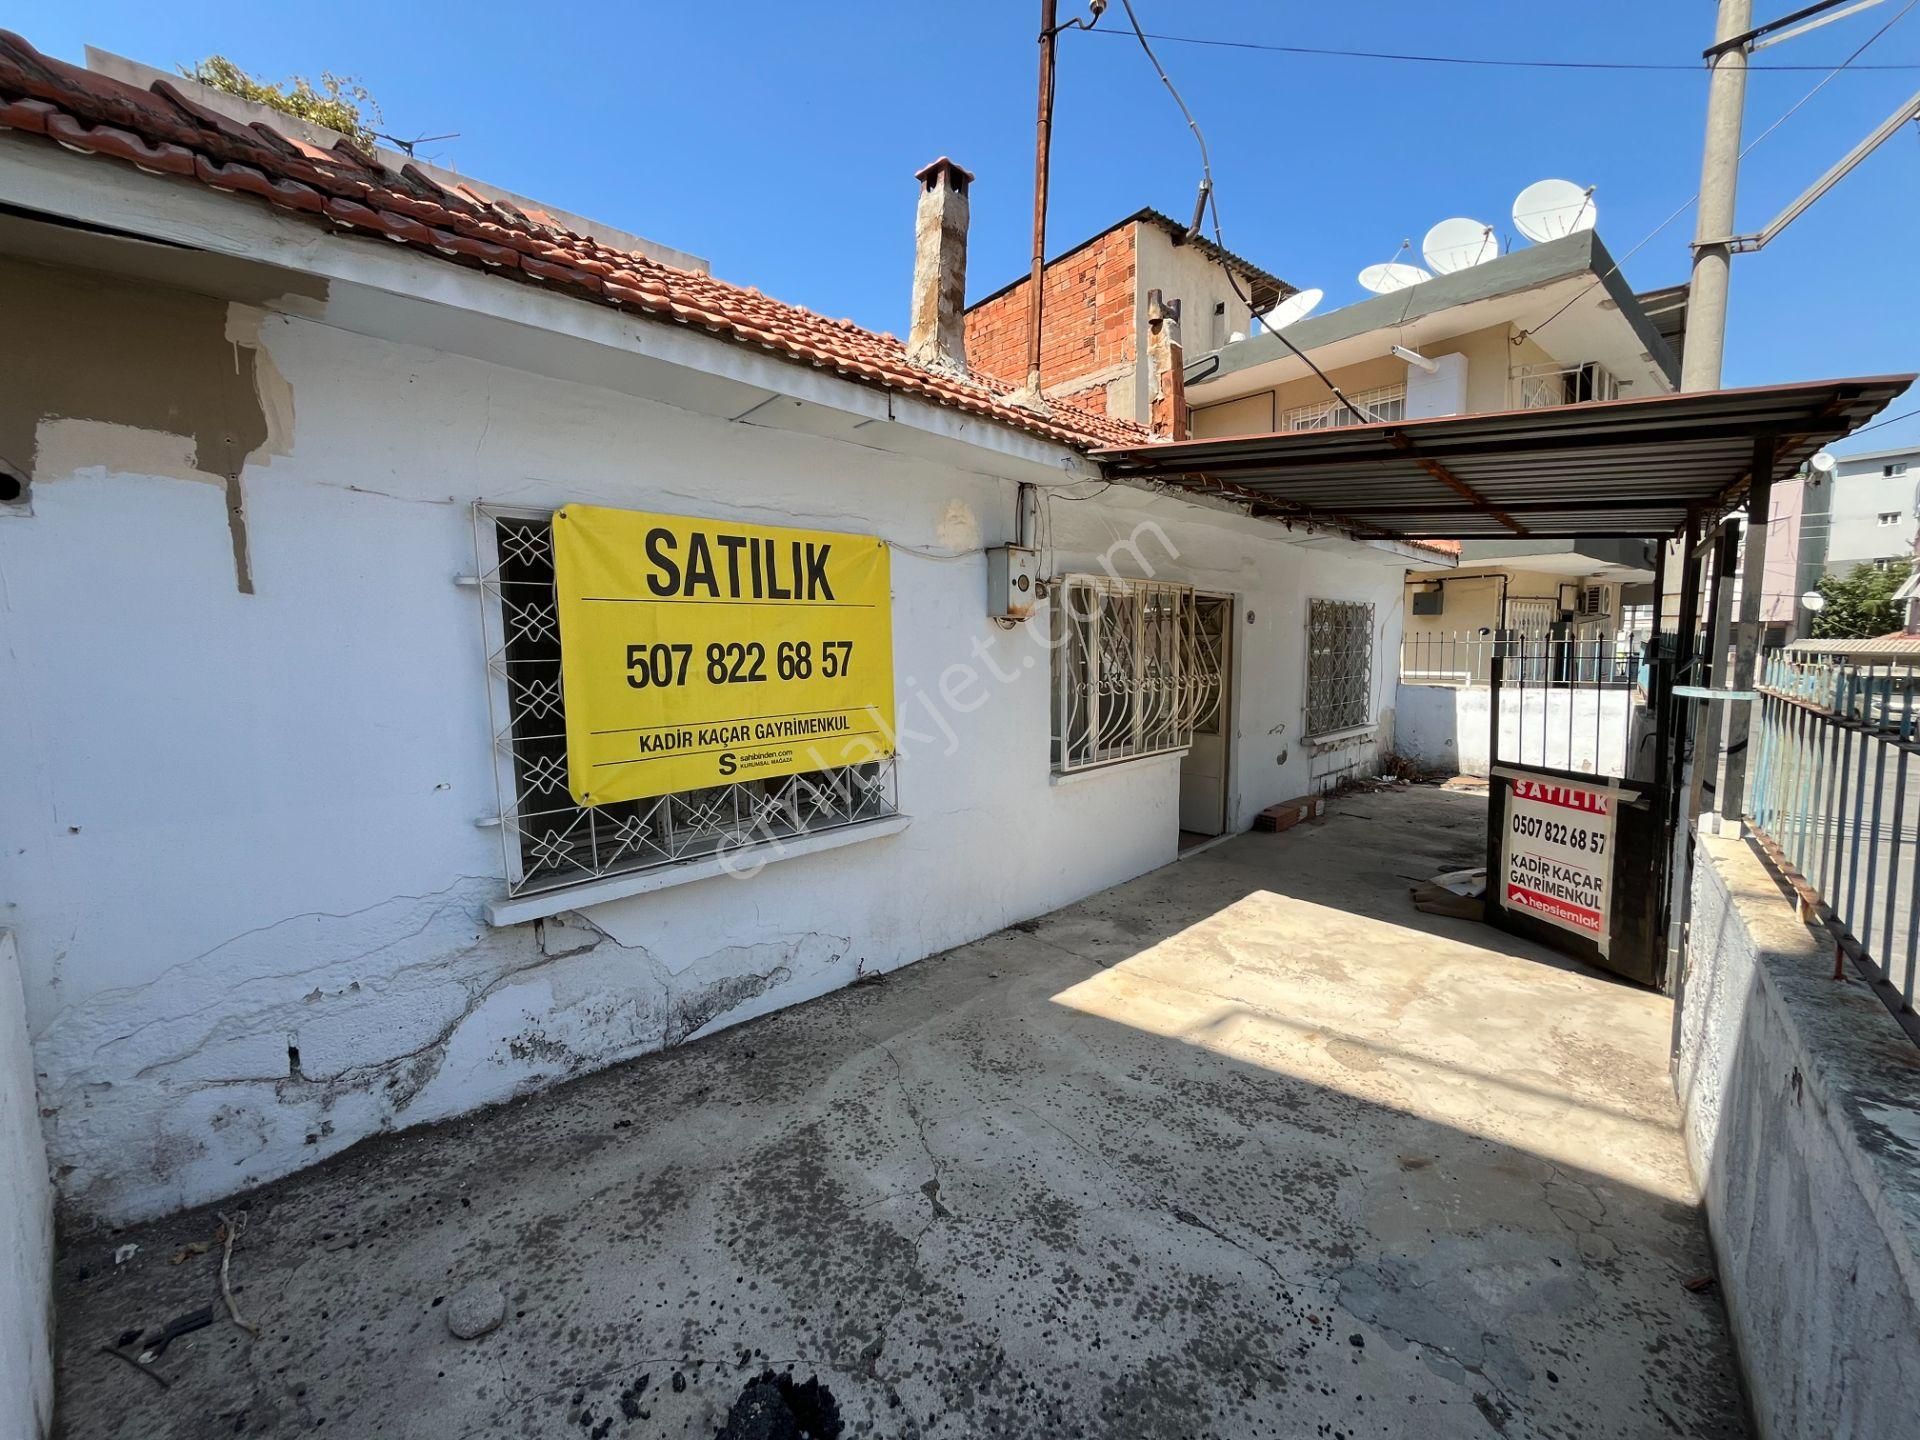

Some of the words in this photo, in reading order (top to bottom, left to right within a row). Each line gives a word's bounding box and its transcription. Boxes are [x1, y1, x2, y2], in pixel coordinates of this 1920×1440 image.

[645, 528, 835, 601] SATILIK
[626, 643, 692, 689] 507
[706, 641, 767, 685] 822
[777, 641, 812, 680] 68
[822, 641, 853, 678] 57
[639, 730, 692, 752] KADİR
[698, 727, 750, 748] KAÇAR
[755, 715, 850, 740] GAYRİMENKUL
[719, 753, 737, 775] S
[740, 750, 793, 762] sahibinden.com
[740, 760, 770, 769] KURUMSAL
[771, 757, 793, 765] MAĞAZA
[1516, 779, 1608, 811] SATILIK
[1513, 814, 1542, 838] 0507
[1545, 821, 1567, 846] 822
[1570, 828, 1587, 850] 68
[1590, 831, 1607, 855] 57
[1510, 870, 1602, 910] GAYRİMENKUL
[1511, 852, 1550, 877] KADİR
[1552, 865, 1603, 892] KAÇAR
[1529, 896, 1600, 929] hepsiemlak
